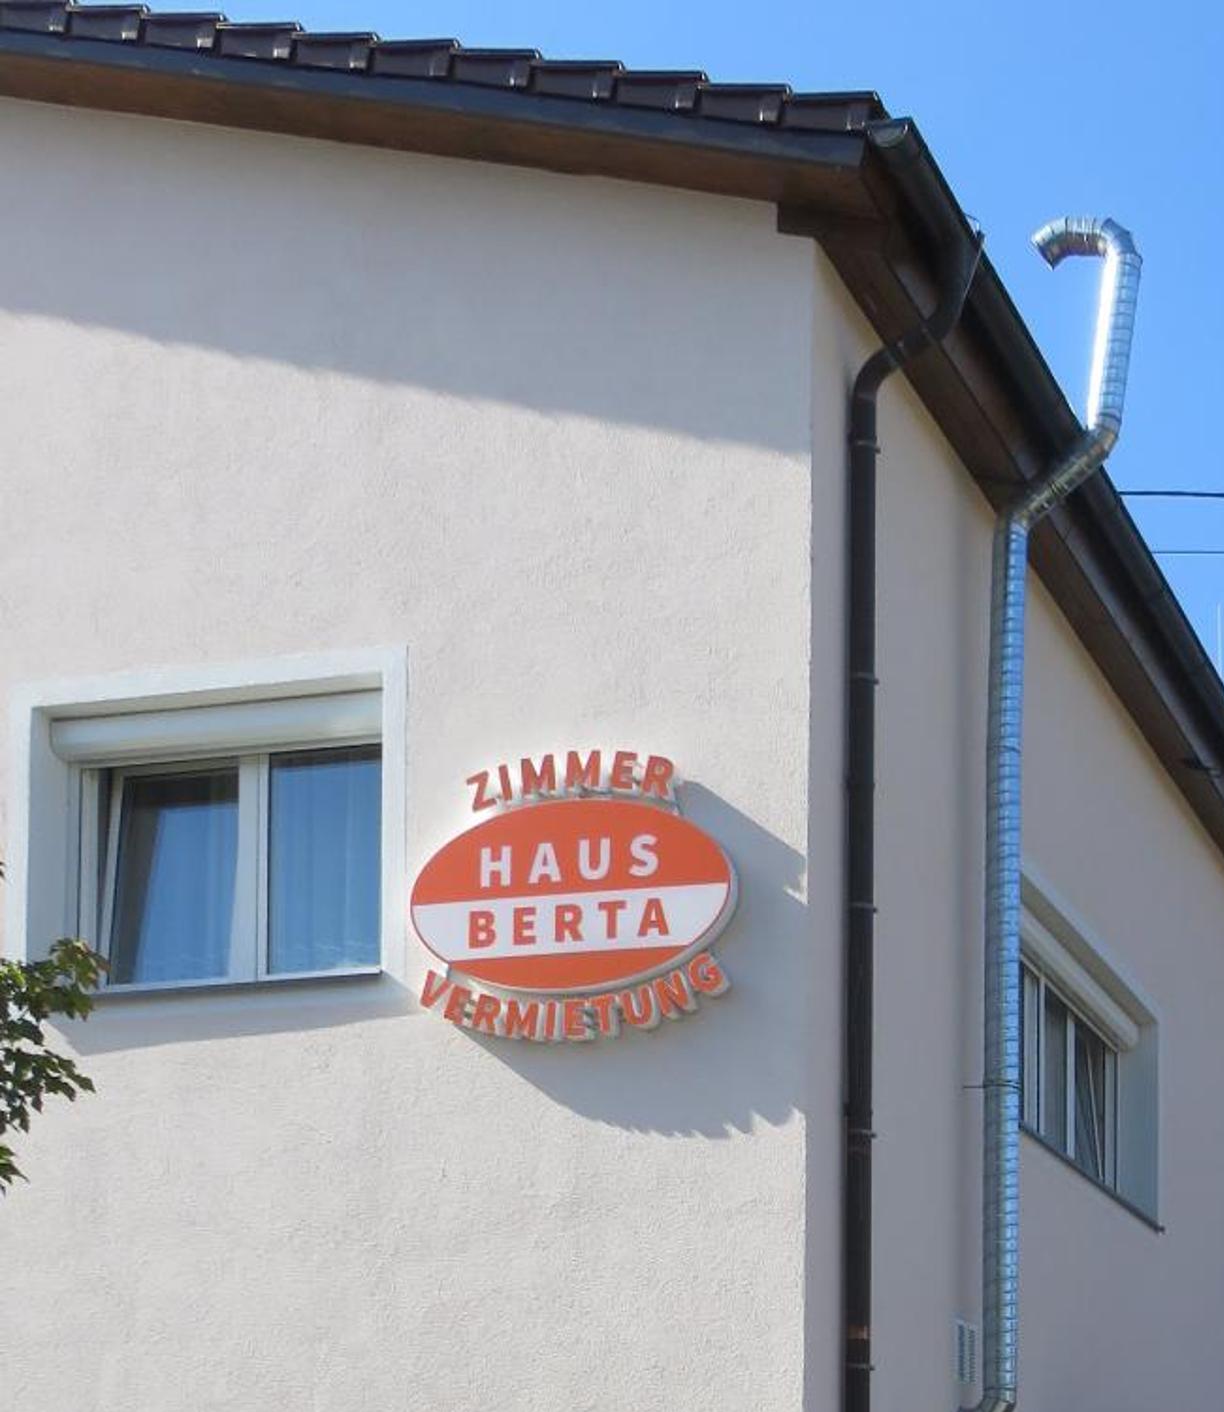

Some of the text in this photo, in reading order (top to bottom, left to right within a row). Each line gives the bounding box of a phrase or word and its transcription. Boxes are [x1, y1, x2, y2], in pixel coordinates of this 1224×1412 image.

[466, 750, 675, 813] ZIMMER
[479, 834, 660, 889] HAUS
[468, 898, 670, 950] BERTA
[418, 952, 725, 1038] VERMIETUNG
